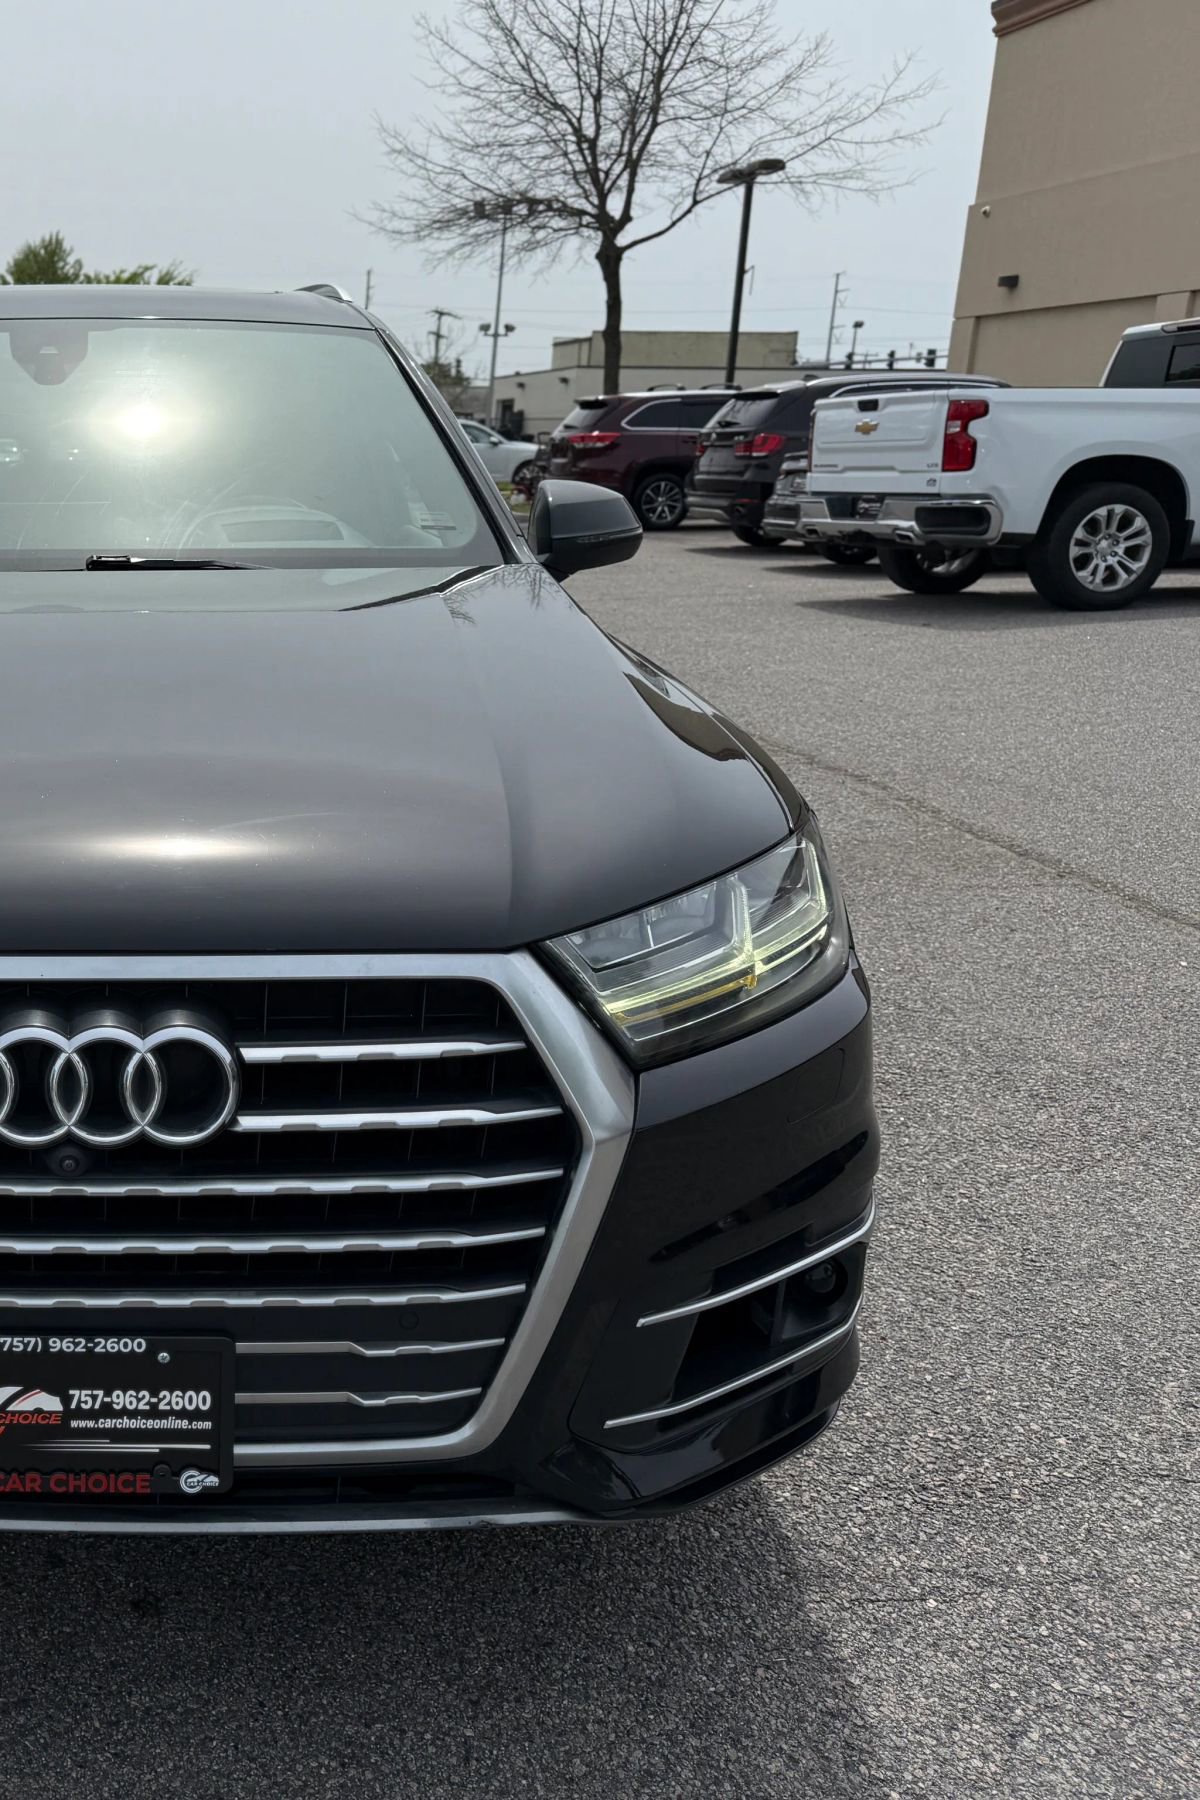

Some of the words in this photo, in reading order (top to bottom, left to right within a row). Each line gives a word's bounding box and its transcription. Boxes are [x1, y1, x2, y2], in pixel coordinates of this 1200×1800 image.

[48, 1337, 147, 1353] 962-2600
[68, 1389, 212, 1411] 757-962-2600
[70, 1415, 212, 1430] www.carchoiceonline.com
[49, 1471, 151, 1494] CHOICE
